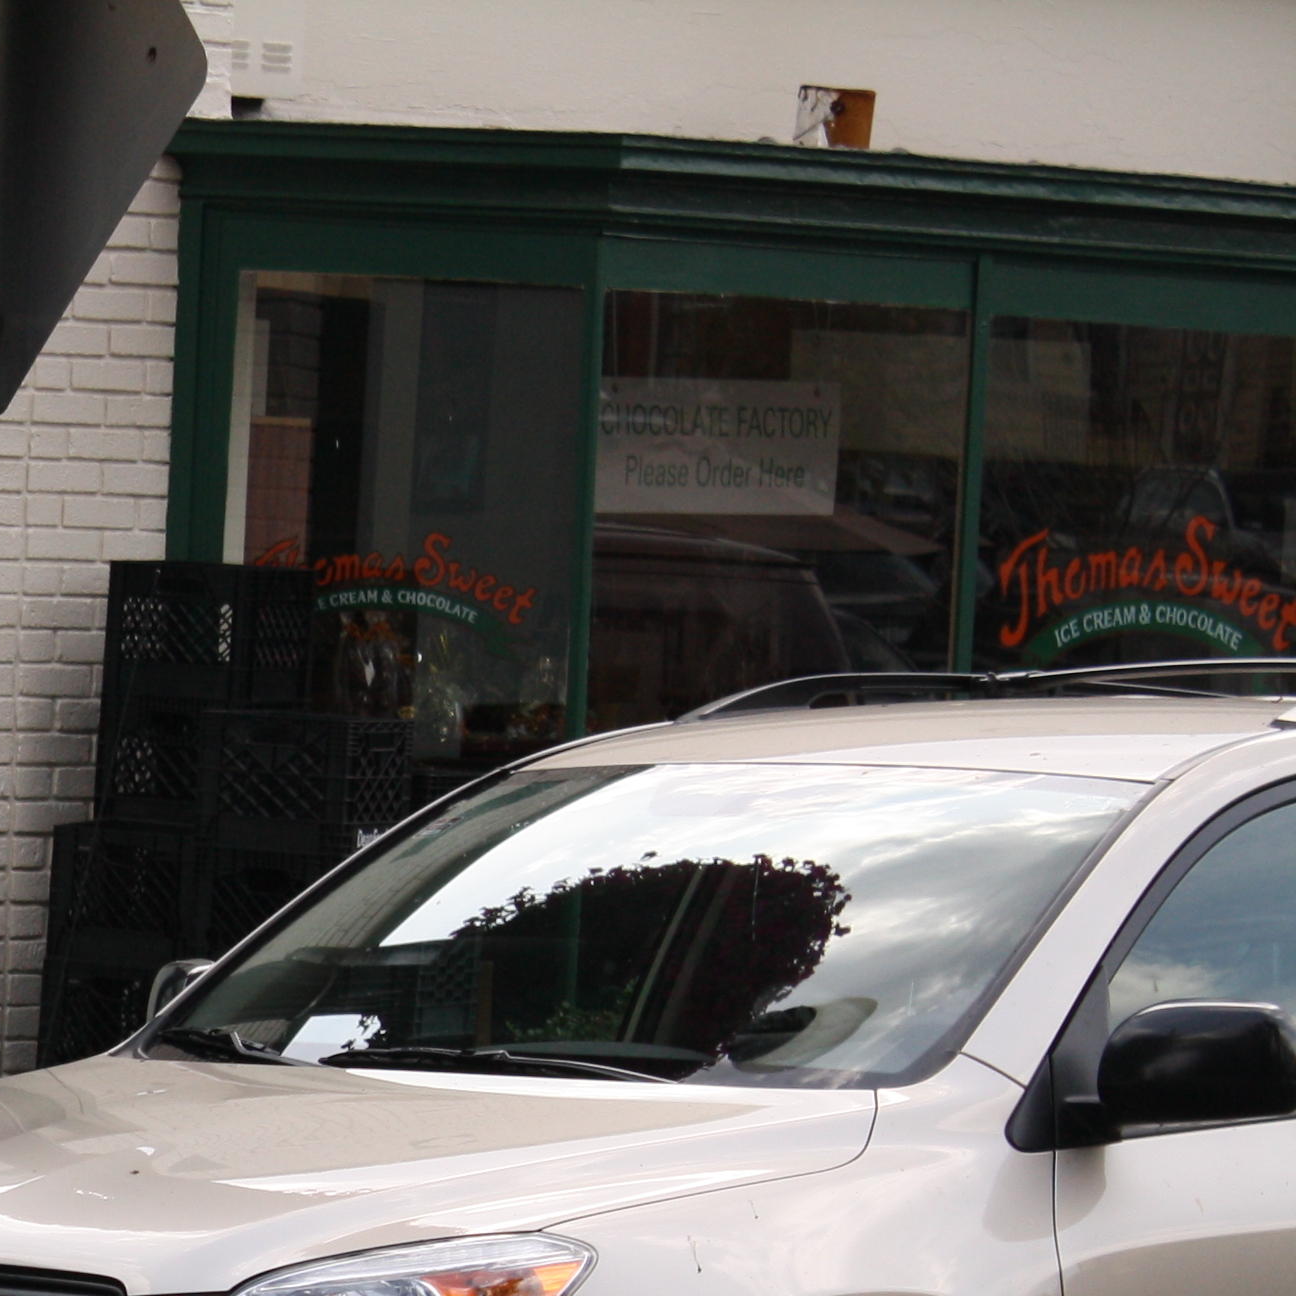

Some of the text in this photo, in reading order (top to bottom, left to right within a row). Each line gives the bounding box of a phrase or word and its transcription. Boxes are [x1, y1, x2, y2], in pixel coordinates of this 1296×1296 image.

[600, 404, 833, 439] CHOCOLATE FACTORY
[625, 456, 805, 488] Please Order Here
[254, 532, 537, 625] omas Sweet
[999, 515, 1296, 651] Thomas Sweet
[329, 590, 378, 607] CREAM
[381, 590, 393, 604] &
[397, 590, 478, 624] CHOCOLATE
[1054, 603, 1243, 651] ICE CREAM & CHOCOLATE
